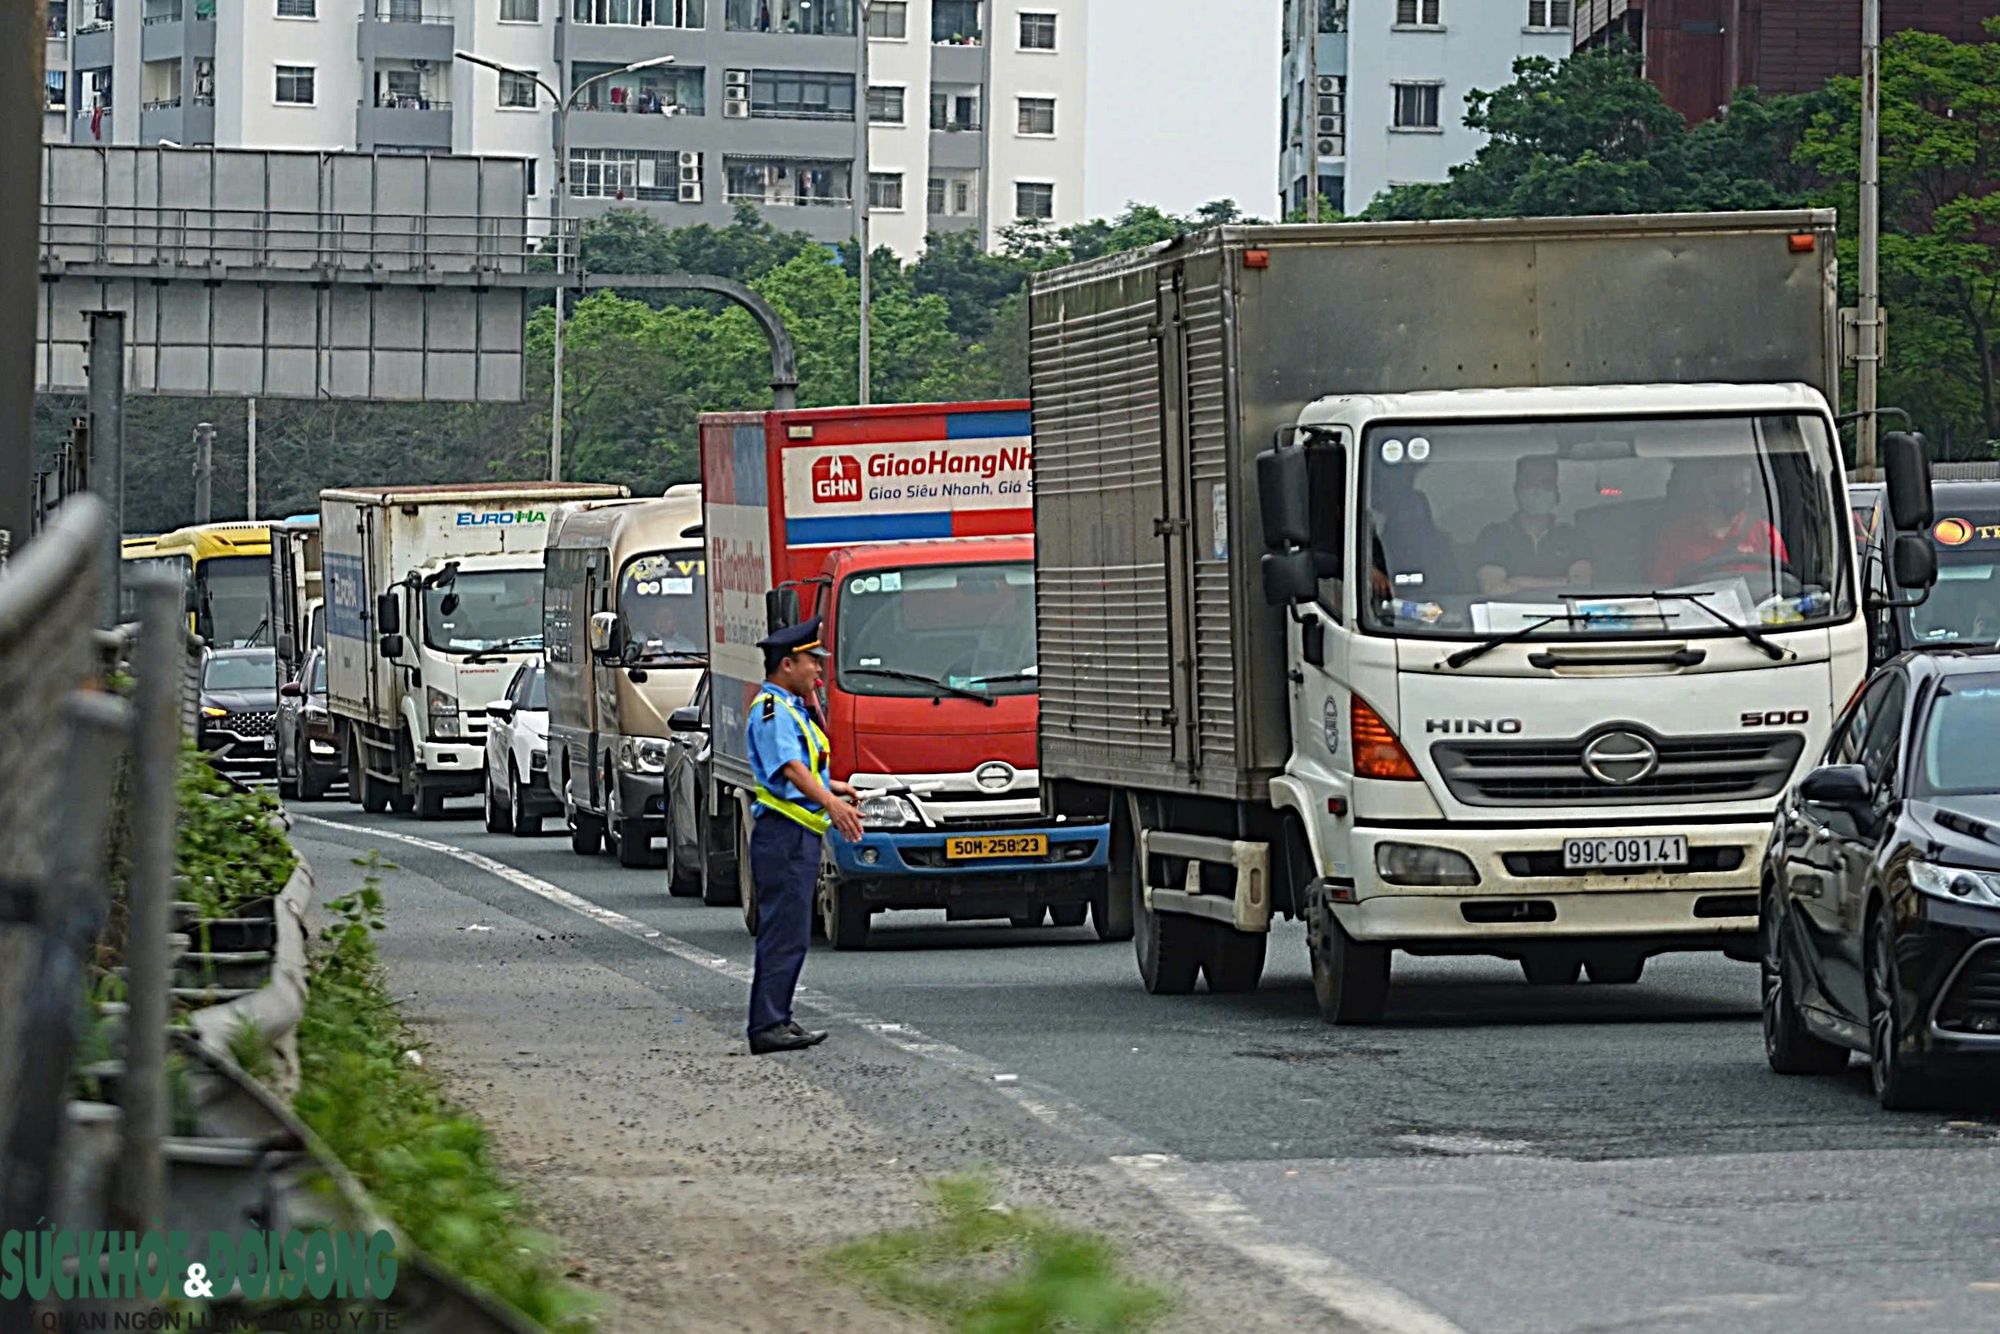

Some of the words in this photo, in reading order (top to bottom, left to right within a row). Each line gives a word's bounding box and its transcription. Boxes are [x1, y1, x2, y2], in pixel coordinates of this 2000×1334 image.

[817, 478, 857, 497] GHN
[869, 485, 902, 500] Giao
[906, 484, 938, 498] Siêu
[942, 481, 993, 497] Nhanh,
[998, 479, 1022, 494] Giá
[1426, 718, 1522, 734] HINO
[1740, 709, 1809, 727] 500
[1568, 838, 1682, 864] 99C-091.41
